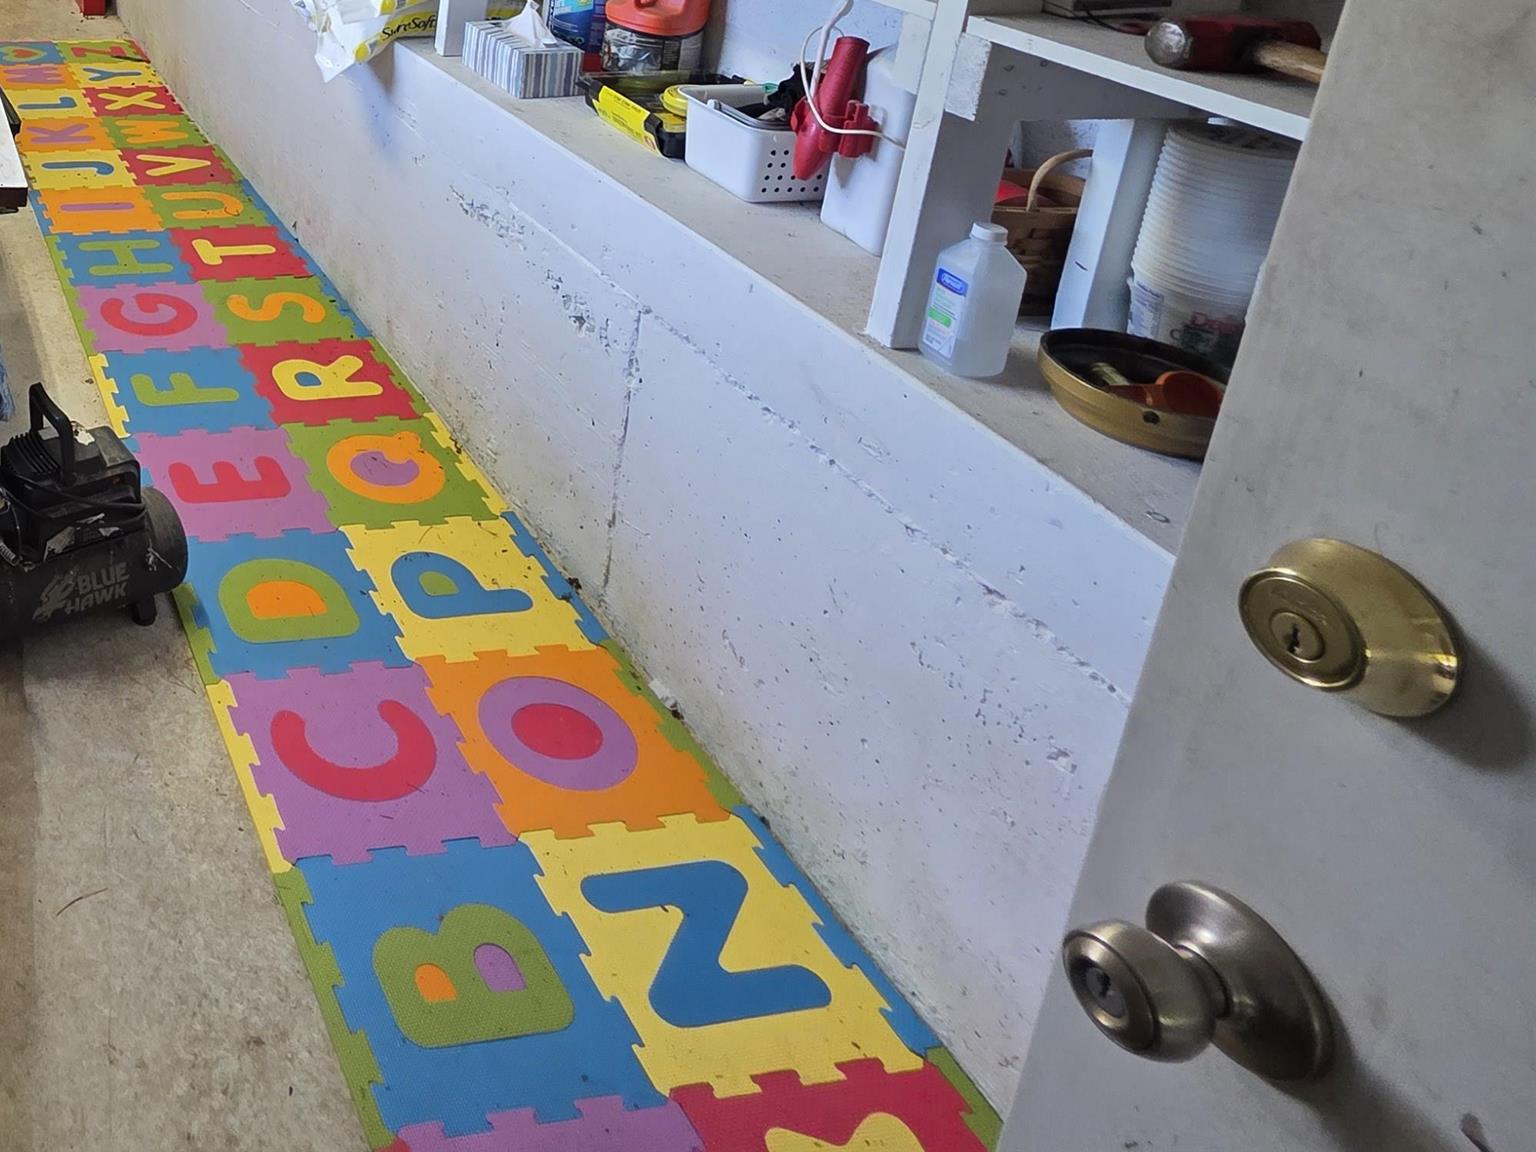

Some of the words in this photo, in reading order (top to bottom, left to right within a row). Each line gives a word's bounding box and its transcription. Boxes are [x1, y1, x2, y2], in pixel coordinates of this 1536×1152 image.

[380, 15, 437, 42] SureSoft
[83, 67, 142, 82] Y
[18, 96, 77, 109] L
[98, 91, 166, 110] X
[26, 123, 95, 144] K
[115, 119, 187, 145] W
[41, 160, 114, 176] J
[136, 153, 212, 177] V
[60, 201, 135, 212] I
[161, 191, 244, 220] U
[78, 239, 174, 276] H
[191, 239, 276, 266] T
[100, 292, 199, 336] G
[227, 292, 326, 324] S
[129, 372, 240, 407] F
[272, 355, 383, 400] R
[168, 455, 292, 504] E
[326, 431, 446, 505] Q
[76, 562, 130, 596] BLUE
[391, 551, 534, 620] P
[64, 581, 128, 615] HAWK
[218, 557, 361, 643] D
[270, 699, 438, 802] C
[477, 675, 640, 792] O
[579, 859, 833, 1028] N
[372, 903, 576, 1048] B
